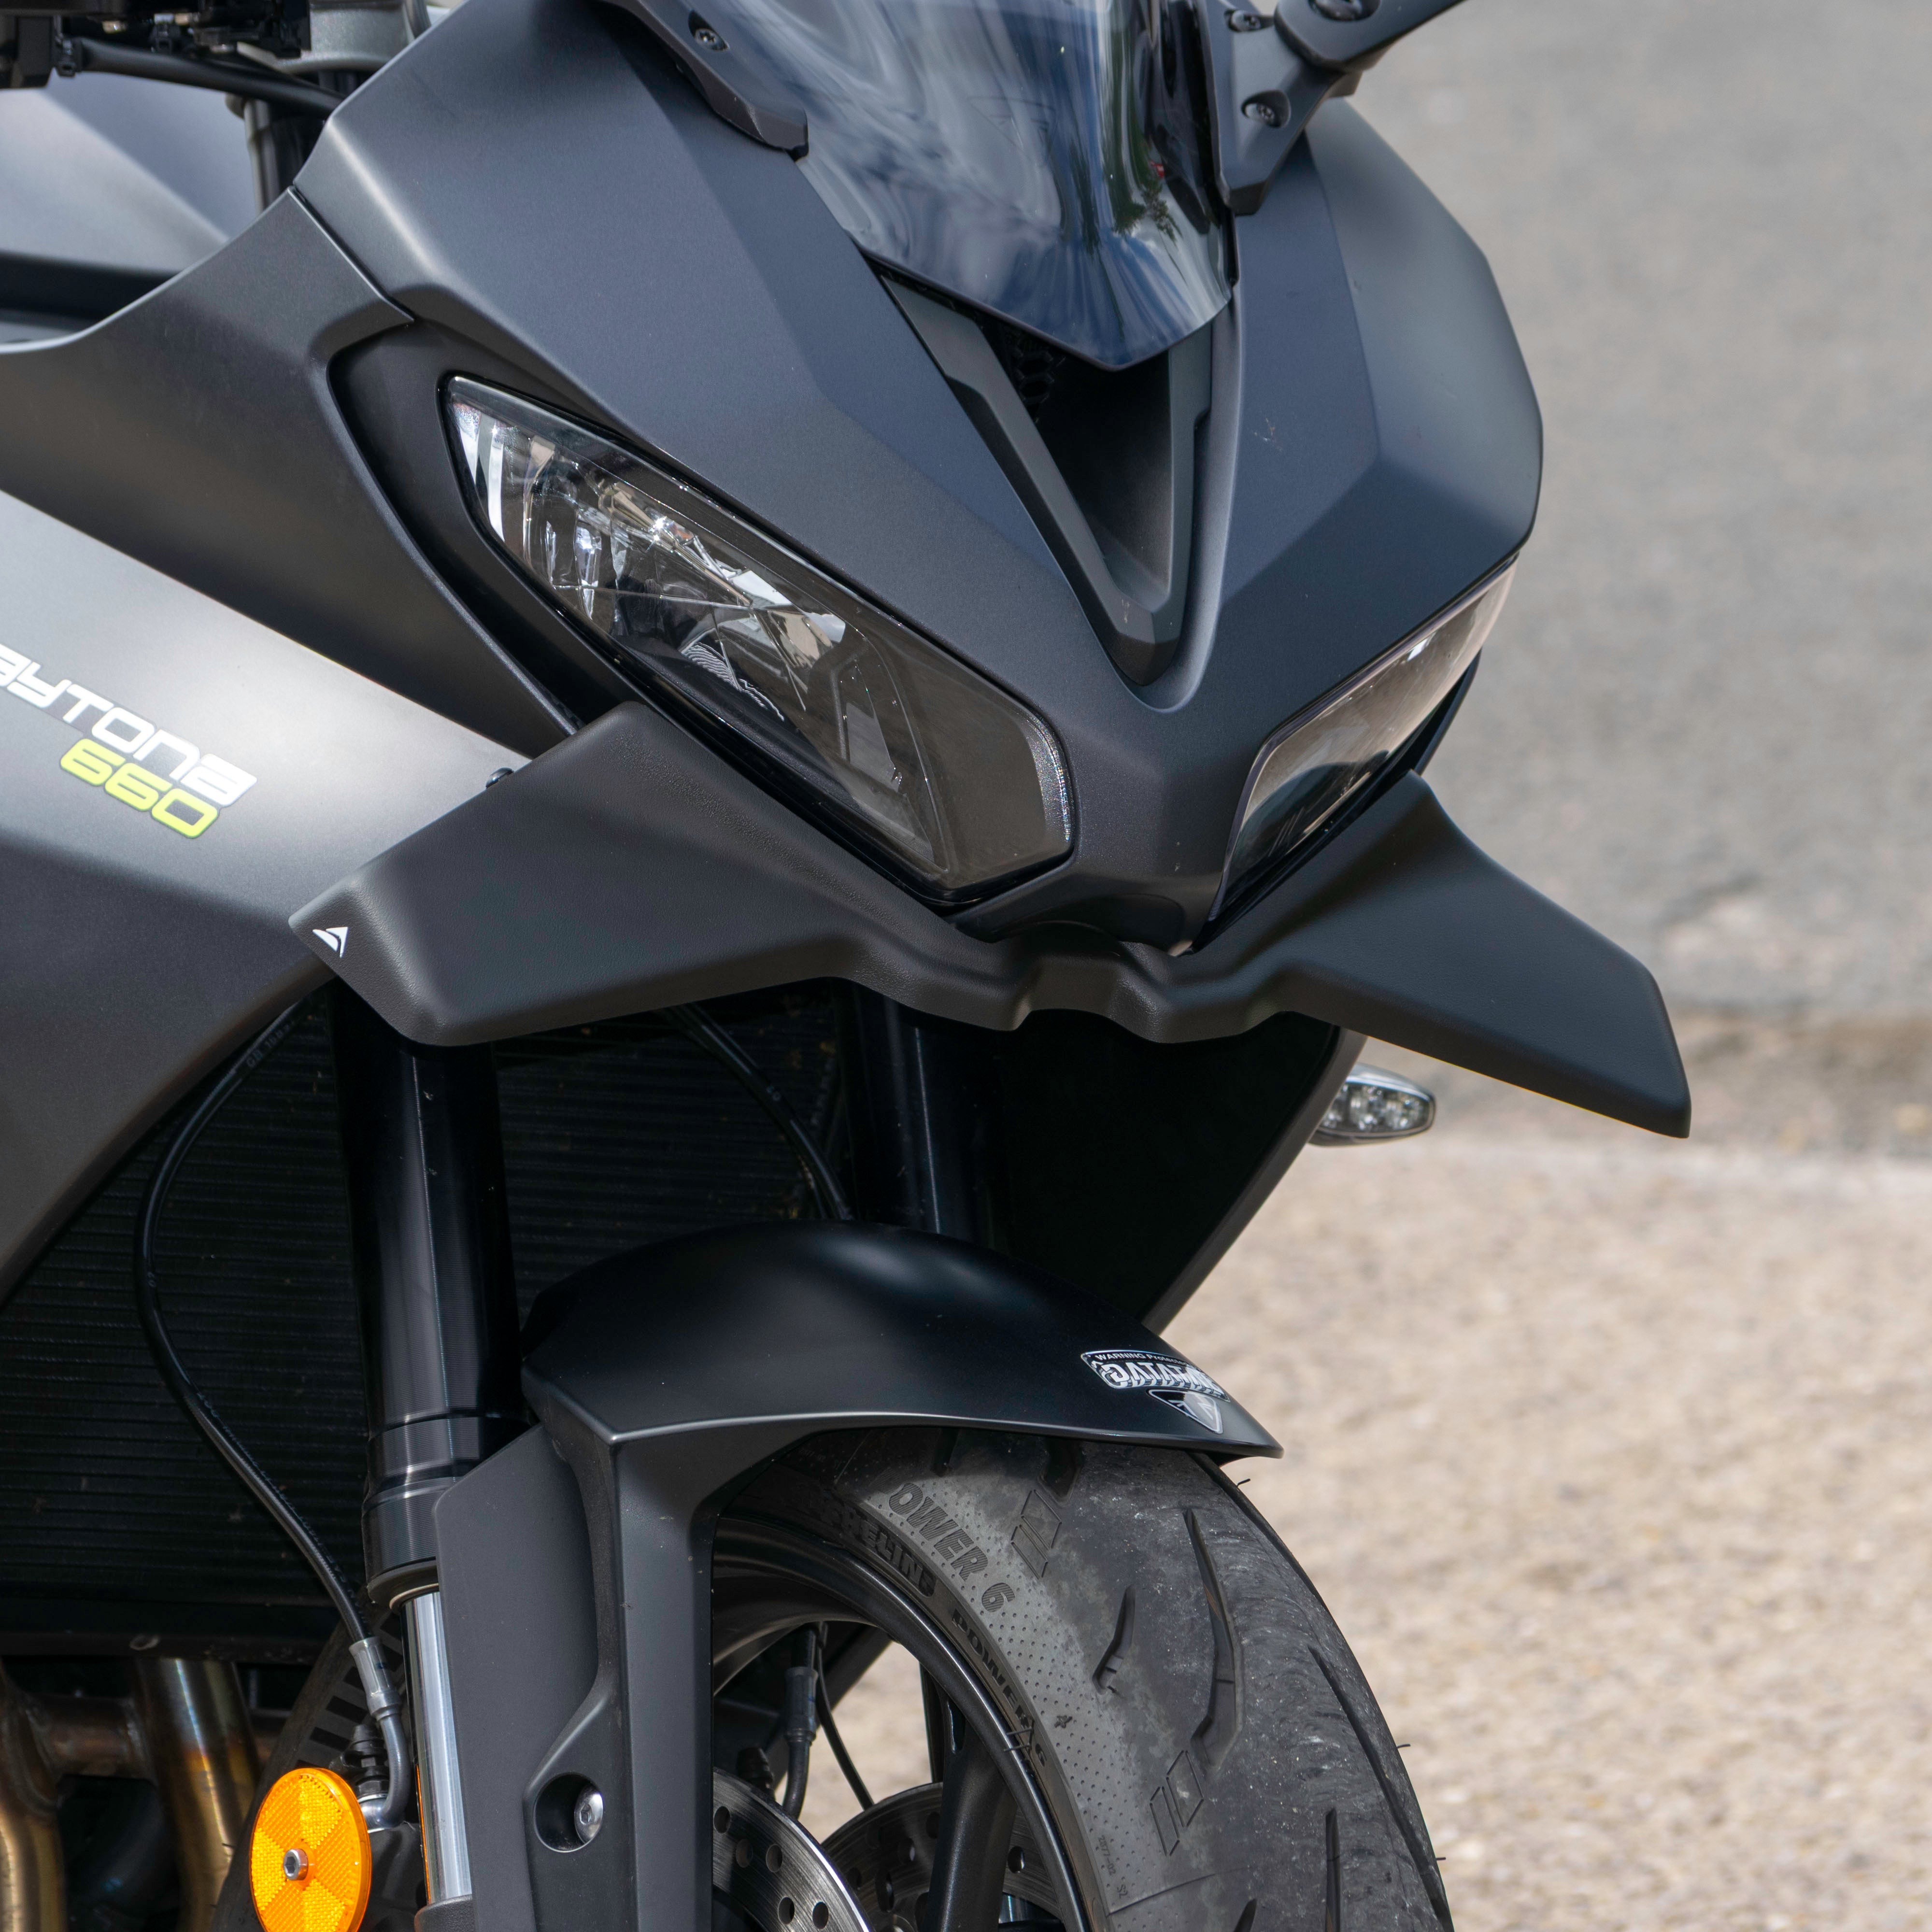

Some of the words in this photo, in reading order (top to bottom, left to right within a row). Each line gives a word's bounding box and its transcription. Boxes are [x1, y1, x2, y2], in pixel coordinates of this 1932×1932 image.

[60, 739, 219, 838] 660
[981, 1582, 1015, 1612] 6
[952, 1608, 1030, 1729] POWER
